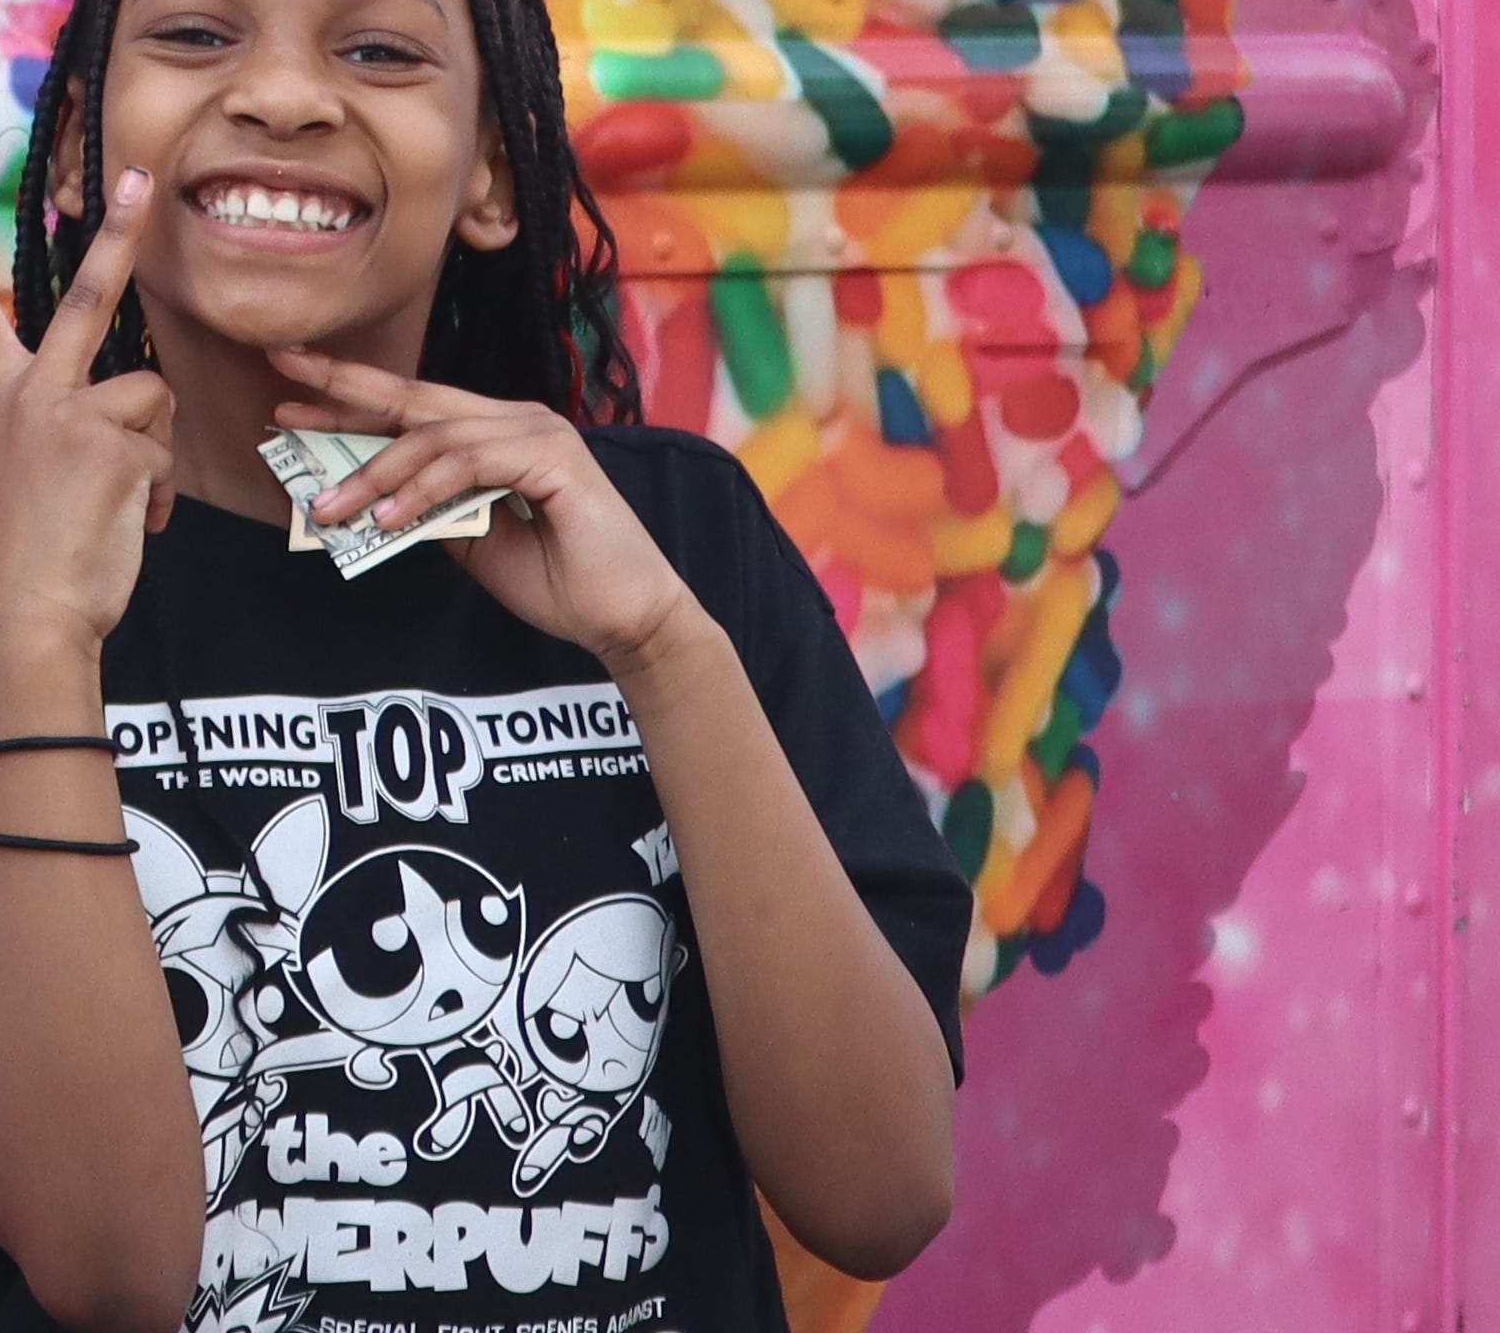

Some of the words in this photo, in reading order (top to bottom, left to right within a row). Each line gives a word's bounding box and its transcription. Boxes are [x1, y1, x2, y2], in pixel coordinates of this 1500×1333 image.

[156, 769, 213, 790] THE
[219, 767, 321, 788] WORLD
[320, 696, 480, 823] TOP
[493, 759, 575, 783] CRIME
[262, 1113, 408, 1186] the
